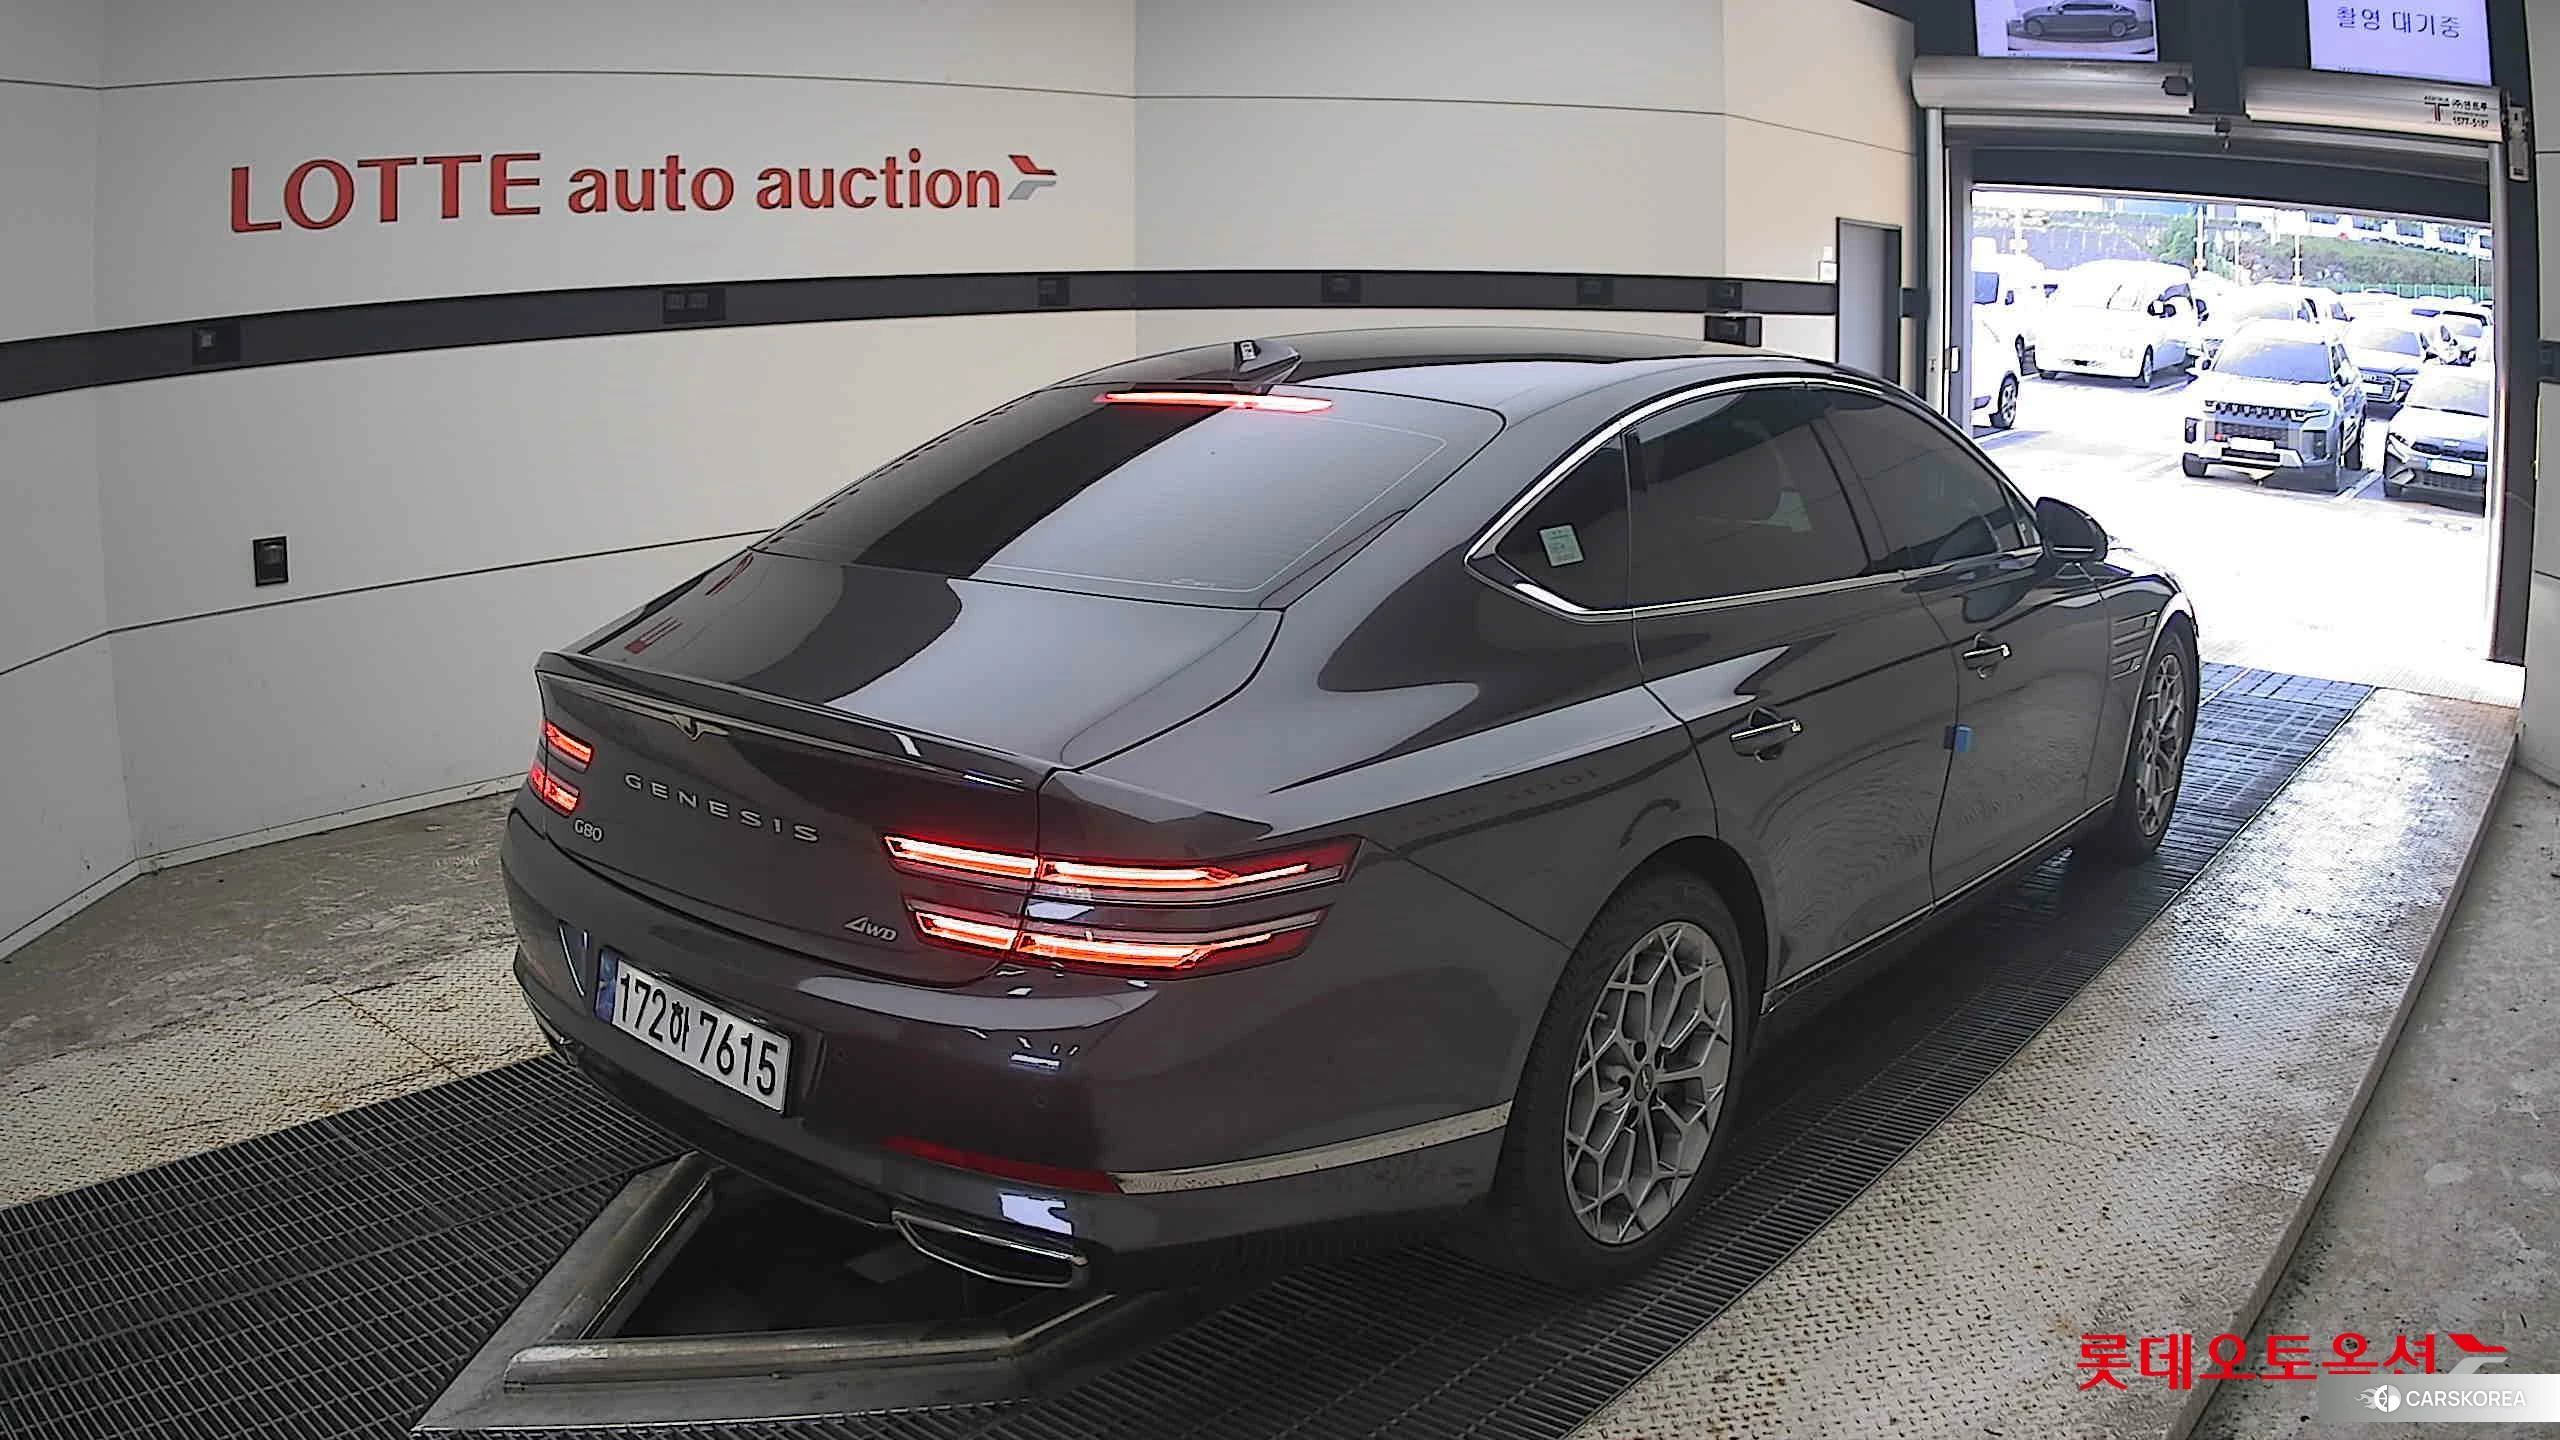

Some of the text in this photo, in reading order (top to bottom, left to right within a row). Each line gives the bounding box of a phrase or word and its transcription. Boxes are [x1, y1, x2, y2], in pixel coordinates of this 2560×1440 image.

[2337, 6, 2460, 39] 촬영 대기중
[232, 148, 1000, 232] LOTTE auto auction
[574, 819, 603, 841] G80
[623, 773, 820, 843] GENESIS
[618, 972, 779, 1096] 172하 7615
